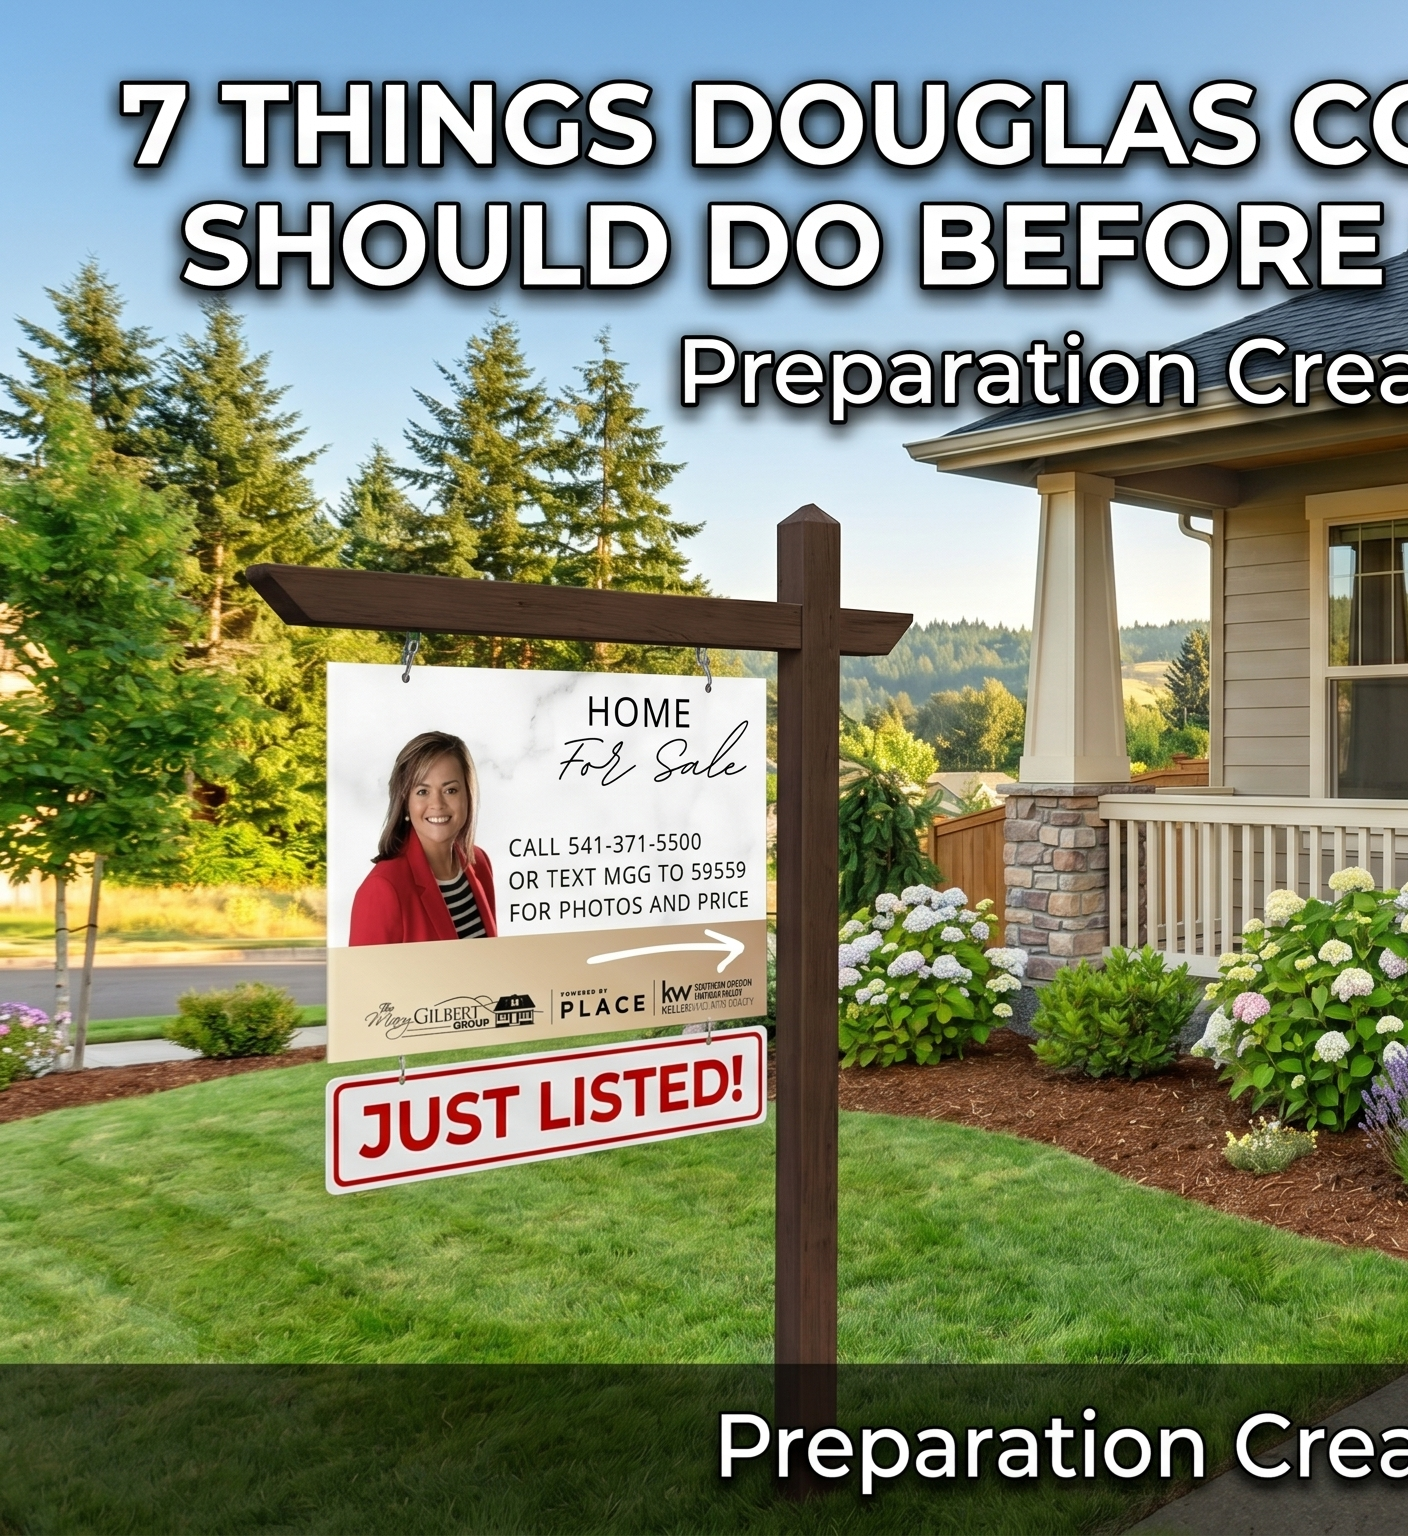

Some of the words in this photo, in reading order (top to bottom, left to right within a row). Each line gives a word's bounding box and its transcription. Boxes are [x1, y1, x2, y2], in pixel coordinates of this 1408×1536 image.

[589, 695, 690, 728] HOME
[558, 737, 637, 787] For
[652, 719, 749, 783] Sale
[509, 837, 560, 858] CALL
[568, 832, 702, 855] 541-371-5500
[509, 870, 539, 890] OR
[546, 867, 597, 888] TEXT
[604, 865, 651, 886] MGG
[657, 863, 684, 883] TO
[691, 861, 746, 881] 59559
[510, 901, 551, 923] FOR
[560, 896, 643, 919] PHOTOS
[649, 893, 690, 914] AND
[698, 890, 749, 911] PRICE
[661, 979, 693, 1004] kw
[413, 1005, 481, 1025] GILBERT
[560, 994, 645, 1019] PLACE
[452, 1018, 490, 1030] GROUP
[359, 1085, 520, 1159] JUST
[540, 1054, 744, 1132] LISTED!
